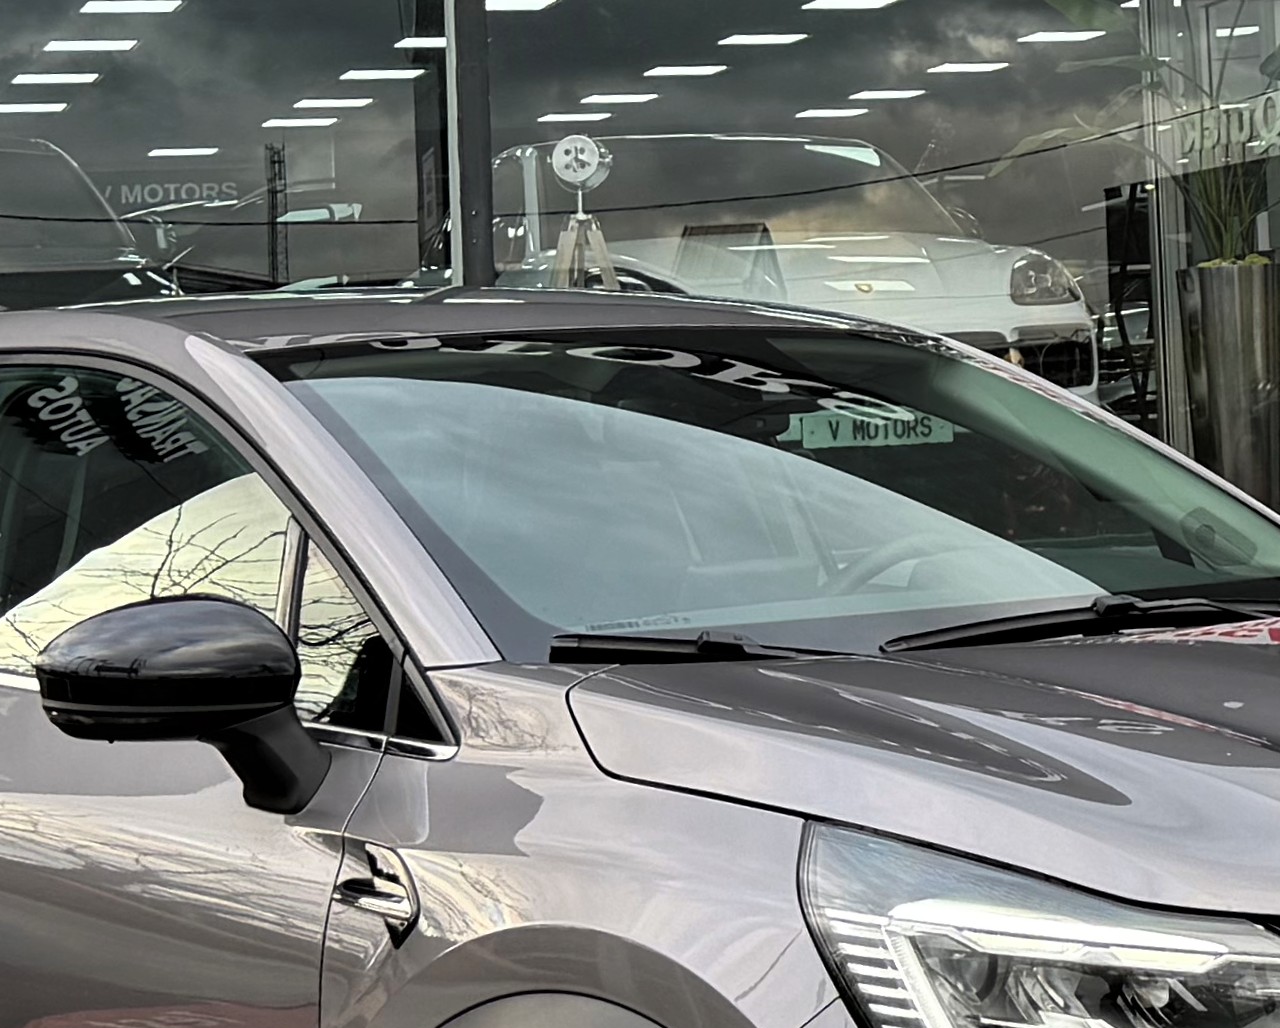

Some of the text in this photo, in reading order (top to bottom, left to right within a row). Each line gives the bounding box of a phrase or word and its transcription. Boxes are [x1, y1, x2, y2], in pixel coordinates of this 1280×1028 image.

[121, 181, 238, 203] MOTORS
[828, 416, 932, 441] V MOTORS
